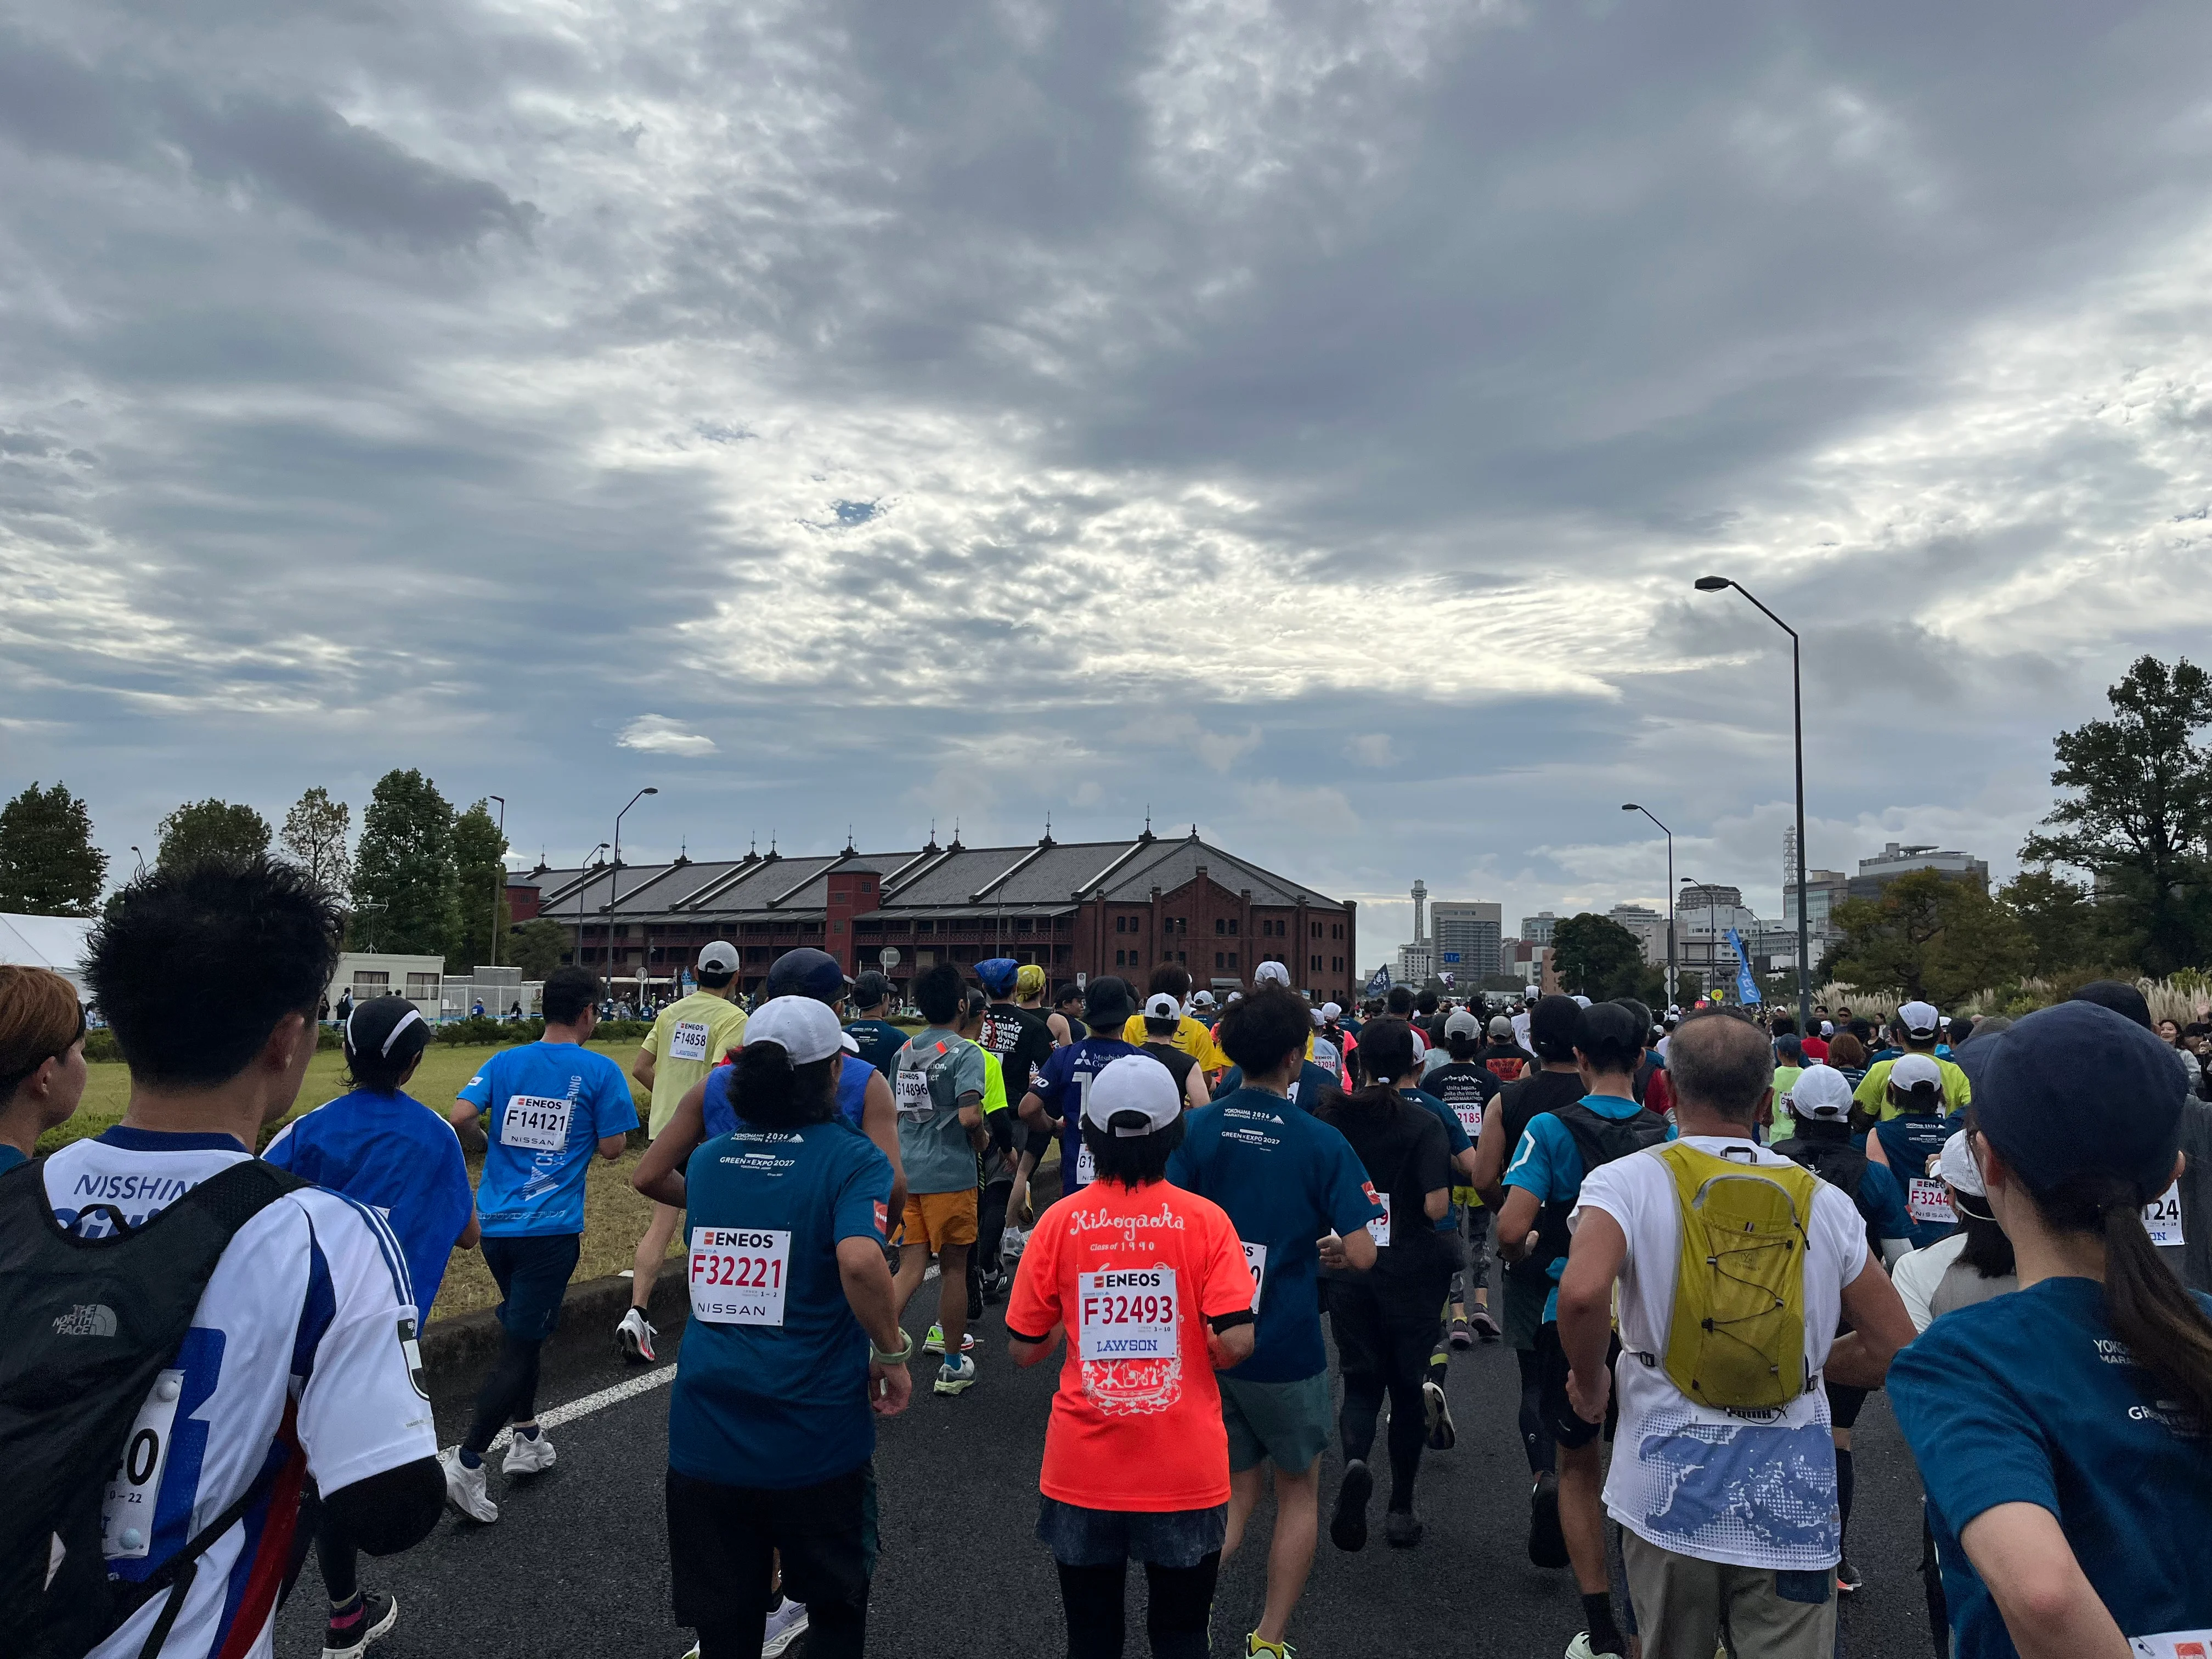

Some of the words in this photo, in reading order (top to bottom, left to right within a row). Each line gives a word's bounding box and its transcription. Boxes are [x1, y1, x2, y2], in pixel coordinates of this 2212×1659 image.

[674, 1032, 706, 1046] F14858
[897, 1082, 928, 1096] G14896
[526, 1099, 562, 1109] ENEOS
[506, 1110, 566, 1131] F14121
[511, 1136, 554, 1146] NISSAN
[1070, 1203, 1186, 1241] Kibogaoka
[715, 1232, 773, 1248] ENEOS
[692, 1255, 781, 1288] F32221
[1107, 1273, 1160, 1287] ENEOS
[698, 1303, 766, 1316] NISSAN
[1085, 1295, 1173, 1325] F32493
[56, 1324, 92, 1335] FACE
[1097, 1340, 1158, 1352] LAWSON
